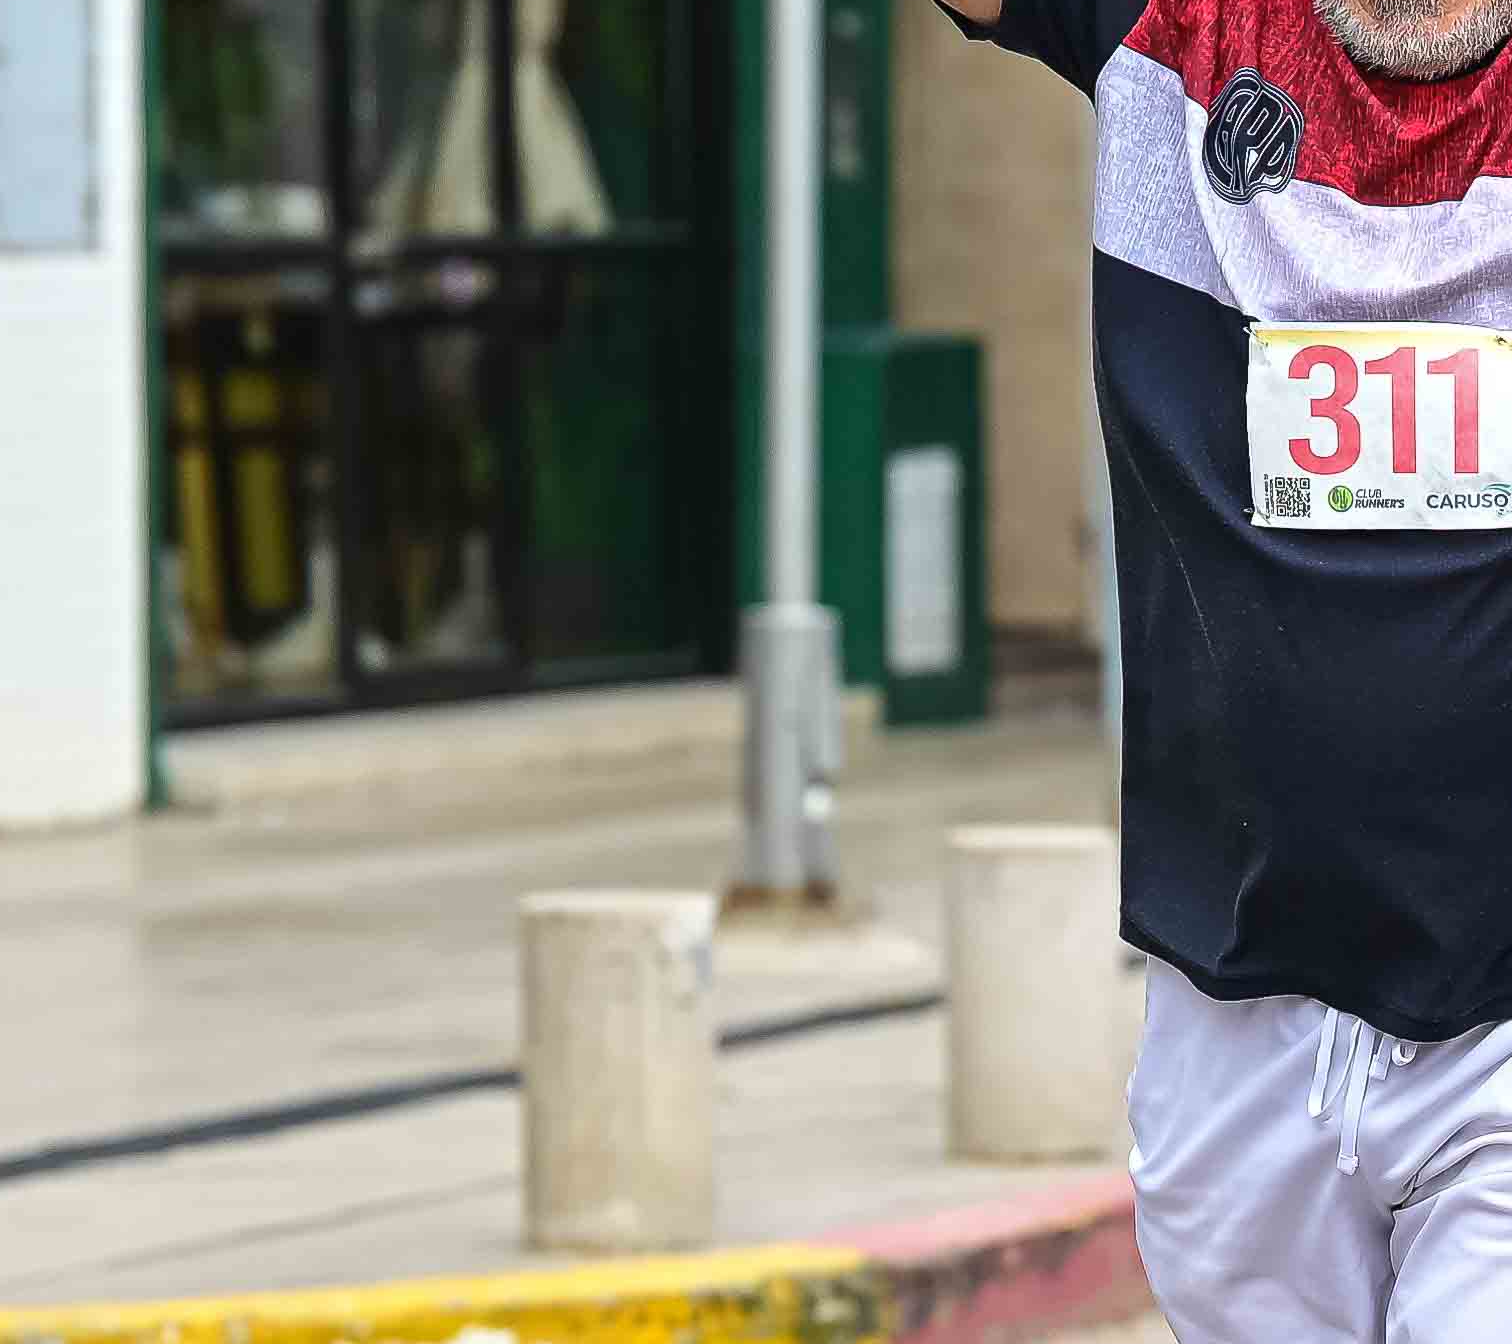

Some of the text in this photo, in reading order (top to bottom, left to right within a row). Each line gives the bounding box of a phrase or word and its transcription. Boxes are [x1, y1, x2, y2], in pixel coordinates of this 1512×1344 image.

[1287, 344, 1480, 475] 311
[1354, 488, 1382, 499] CLUB
[1354, 498, 1405, 509] RUNNER'S
[1426, 493, 1510, 510] CARUSO
